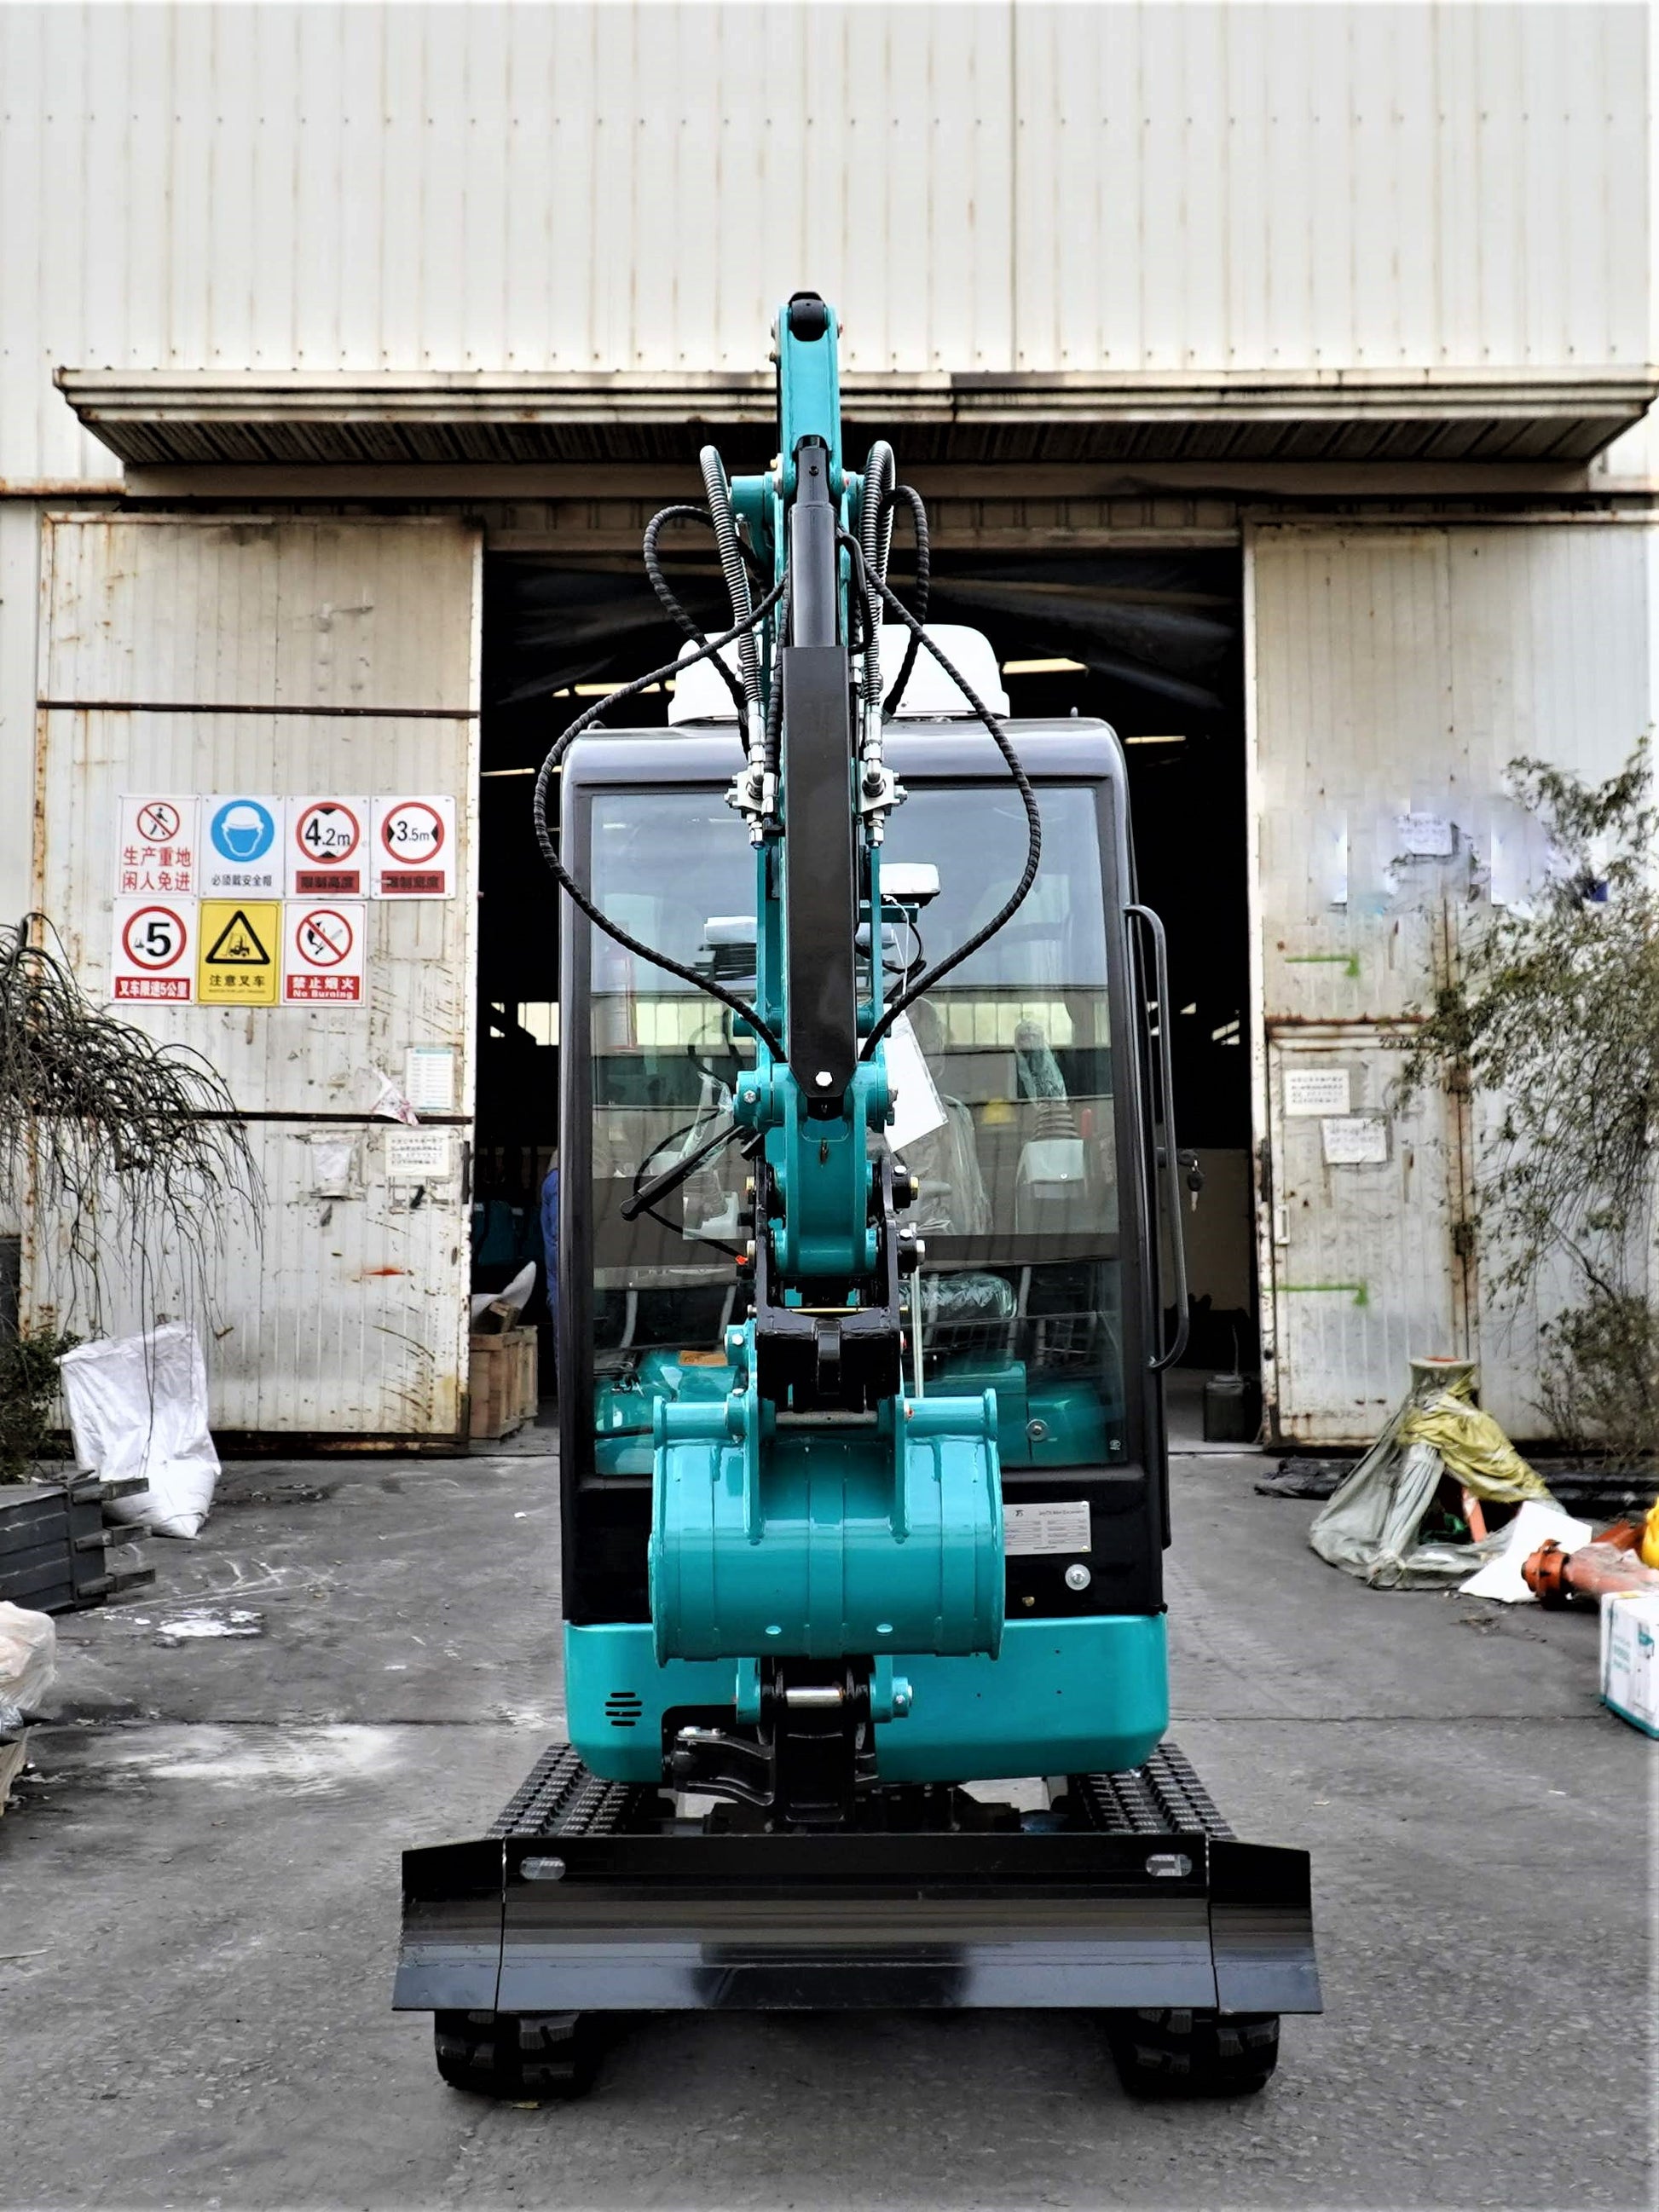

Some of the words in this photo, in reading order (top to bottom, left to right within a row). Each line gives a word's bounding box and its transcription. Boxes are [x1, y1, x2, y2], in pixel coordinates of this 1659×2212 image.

[304, 817, 351, 847] 4.2m
[396, 820, 431, 842] 3.5m
[123, 845, 192, 868] 生产重地
[122, 869, 191, 892] 闲人免进
[211, 874, 273, 887] 必须戴安全帽
[146, 921, 172, 957] 5
[209, 973, 266, 988] 注意叉车
[292, 976, 355, 990] 禁止烟火
[311, 990, 354, 1000] Burning
